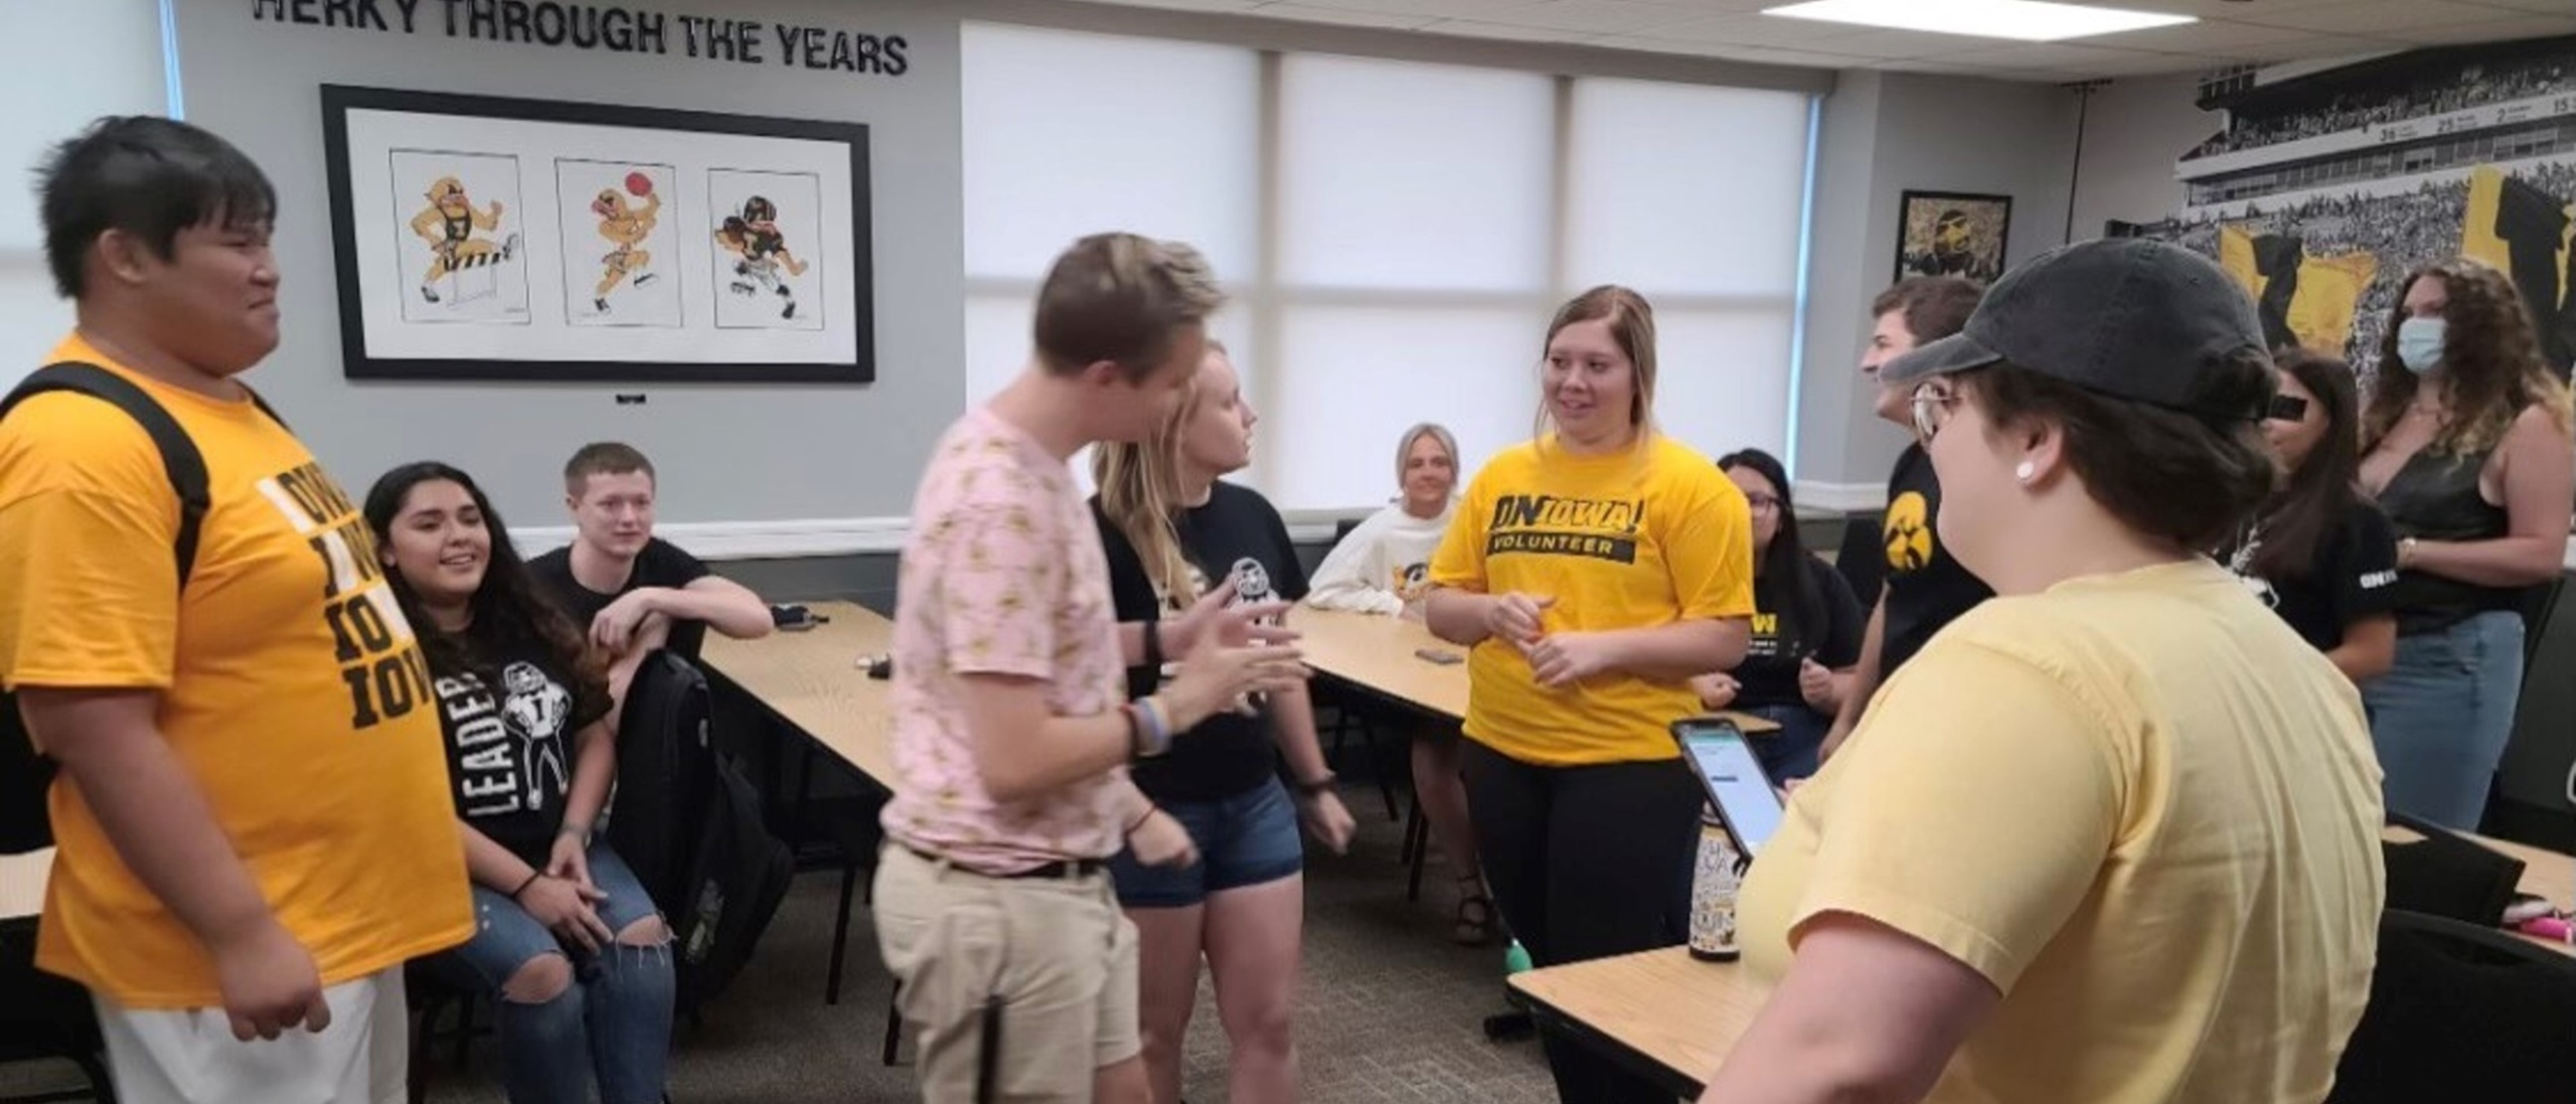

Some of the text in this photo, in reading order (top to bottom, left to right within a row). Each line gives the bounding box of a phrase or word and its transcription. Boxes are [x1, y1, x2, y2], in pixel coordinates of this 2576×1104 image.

[439, 0, 667, 54] THROUGH
[679, 16, 763, 64] THE
[776, 25, 908, 77] YEARS
[1493, 535, 1613, 554] VOLUNTEER
[434, 671, 520, 816] LEADER
